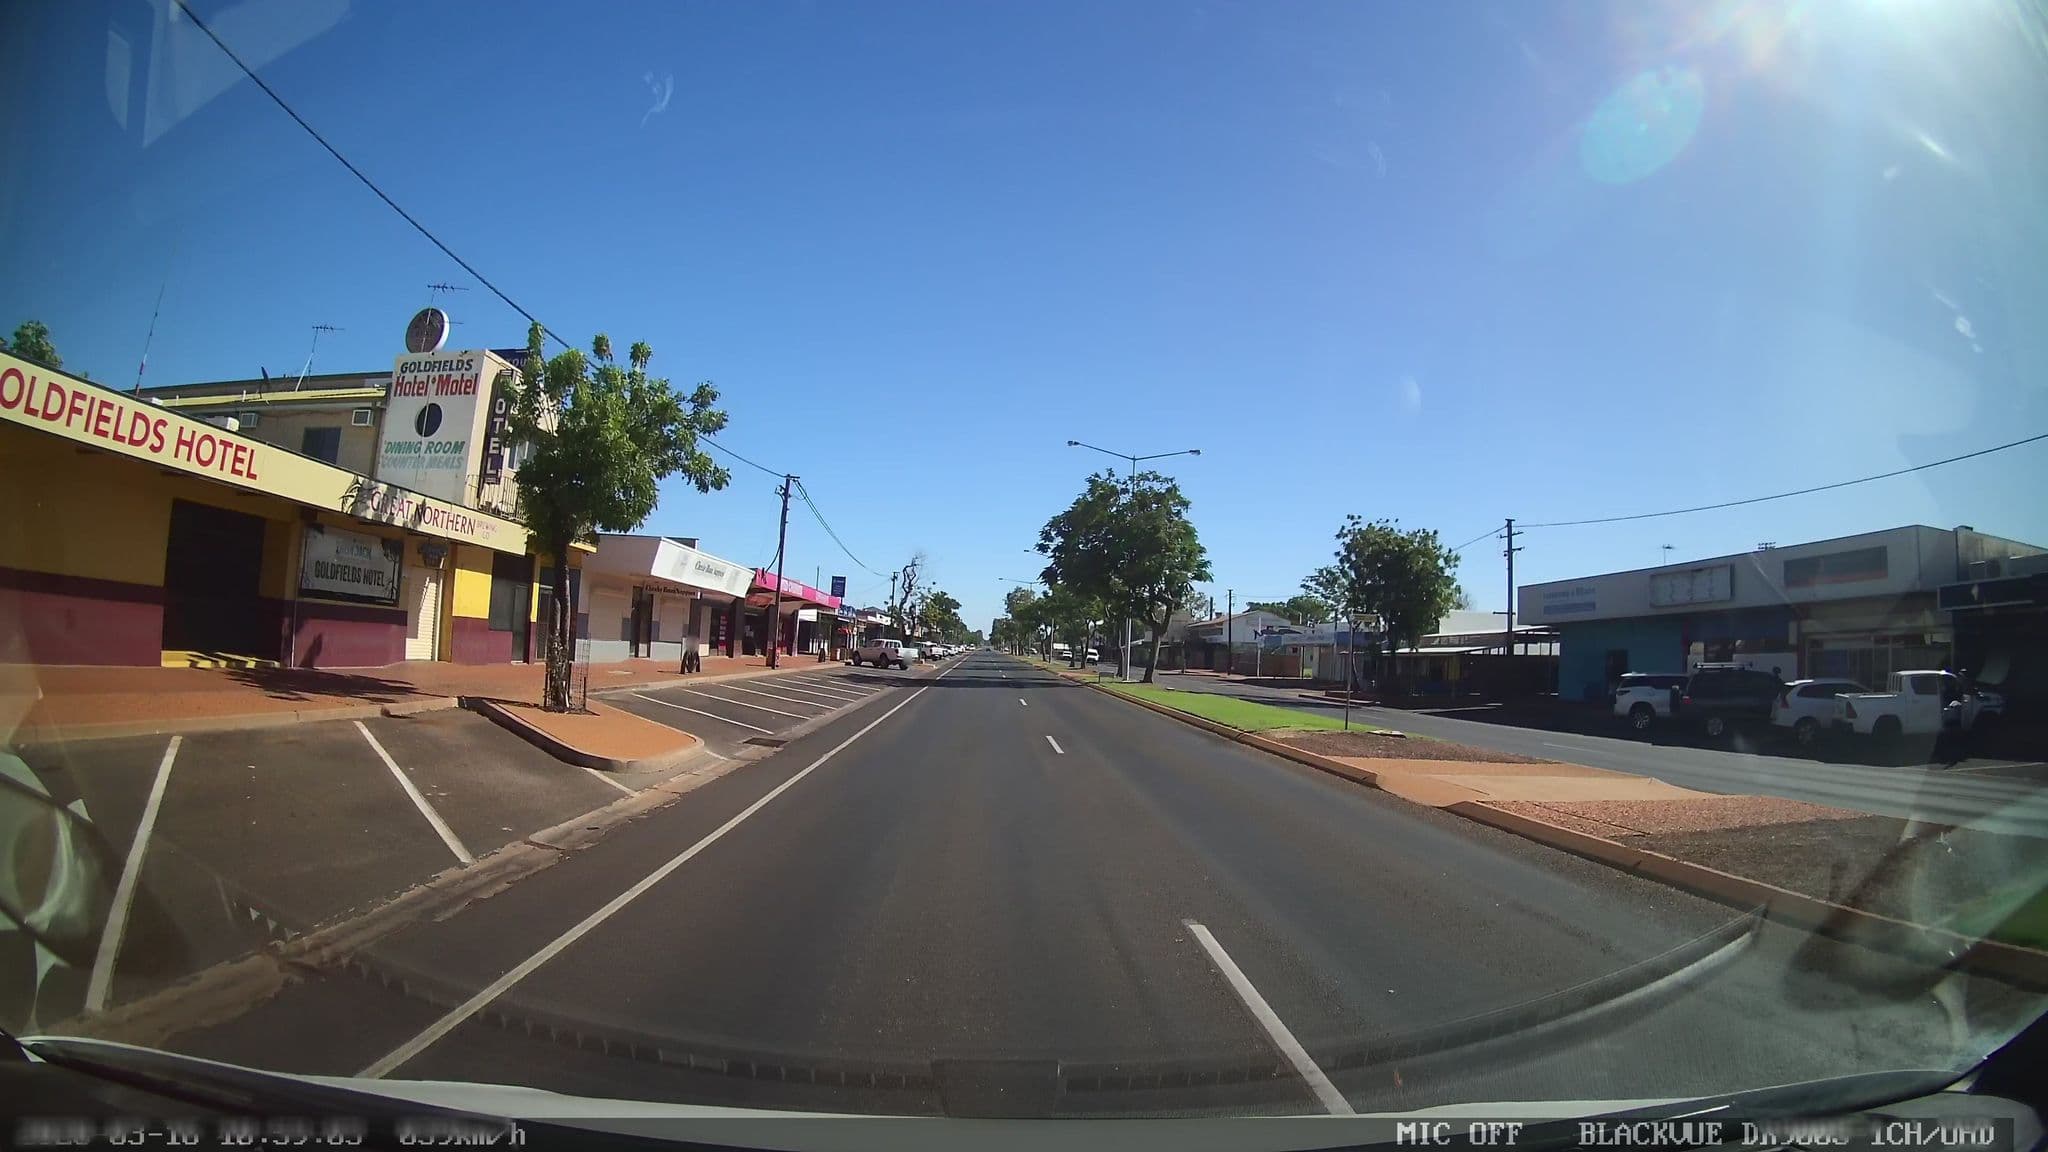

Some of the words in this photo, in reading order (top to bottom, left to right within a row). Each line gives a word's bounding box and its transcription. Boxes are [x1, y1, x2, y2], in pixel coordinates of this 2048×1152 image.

[400, 359, 474, 374] GOLDFIELDS
[393, 374, 430, 397] Hotel
[435, 373, 479, 396] Motel
[174, 425, 258, 480] HOTEL
[384, 441, 422, 454] DINING
[424, 440, 466, 454] ROOM
[371, 490, 414, 519] GREAT
[414, 500, 477, 536] NORTHERN
[314, 559, 361, 583] GOLDFIELDS
[363, 567, 386, 587] HOTEL
